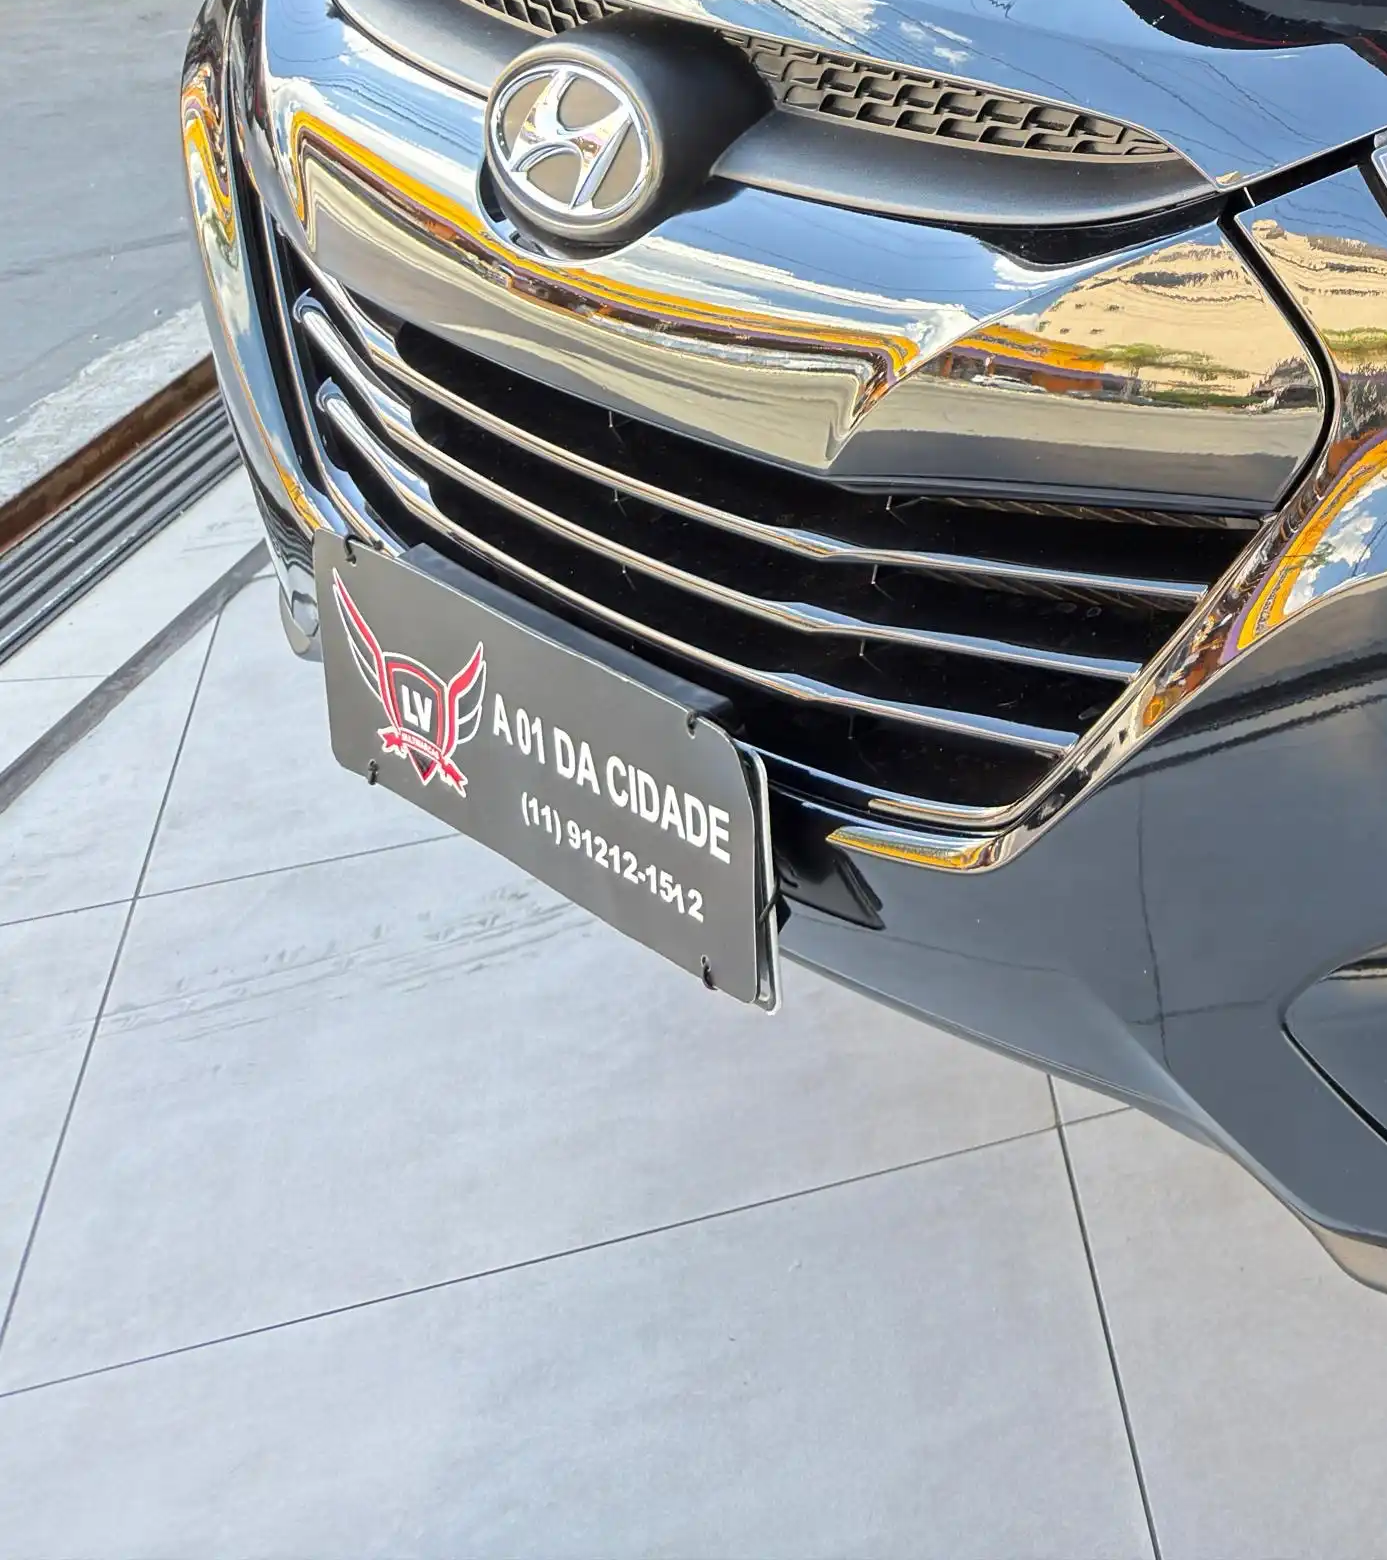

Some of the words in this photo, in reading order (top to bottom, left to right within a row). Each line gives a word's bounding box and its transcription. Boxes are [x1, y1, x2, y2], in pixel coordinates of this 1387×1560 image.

[401, 684, 433, 733] LV
[521, 791, 562, 846] (11)
[567, 819, 704, 923] 91212-1512
[553, 726, 601, 795] DA
[606, 755, 731, 864] CIDADE
